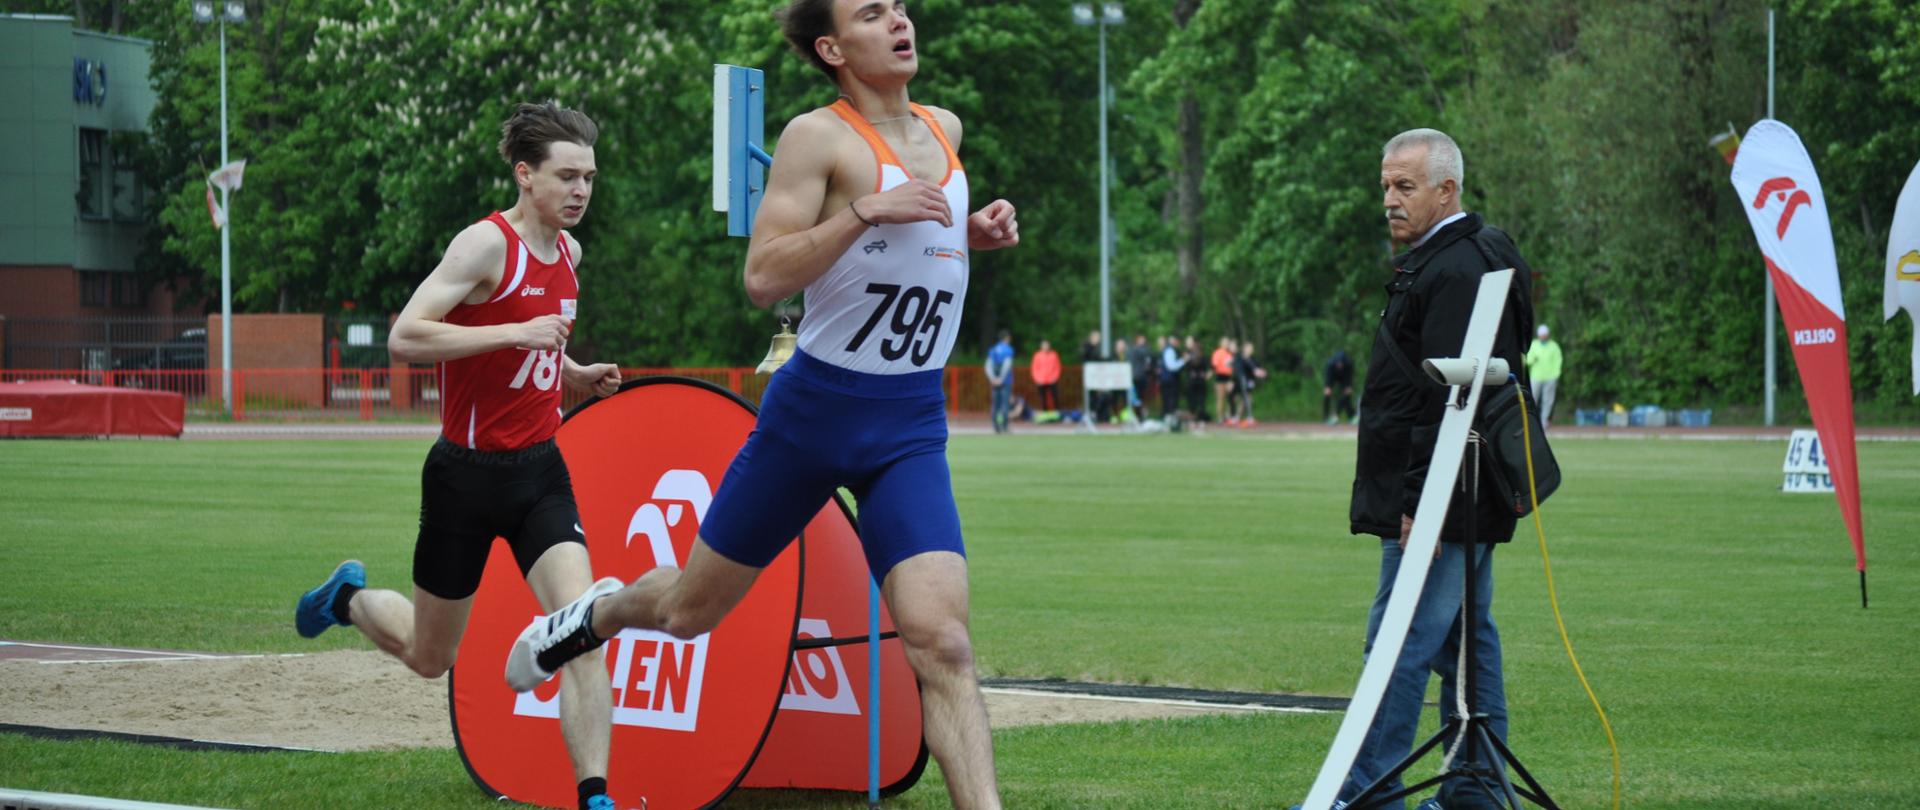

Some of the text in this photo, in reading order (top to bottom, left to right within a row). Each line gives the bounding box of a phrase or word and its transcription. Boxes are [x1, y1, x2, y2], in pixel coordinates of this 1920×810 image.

[844, 283, 954, 367] 795
[1808, 437, 1828, 467] 4
[531, 636, 697, 714] LEN
